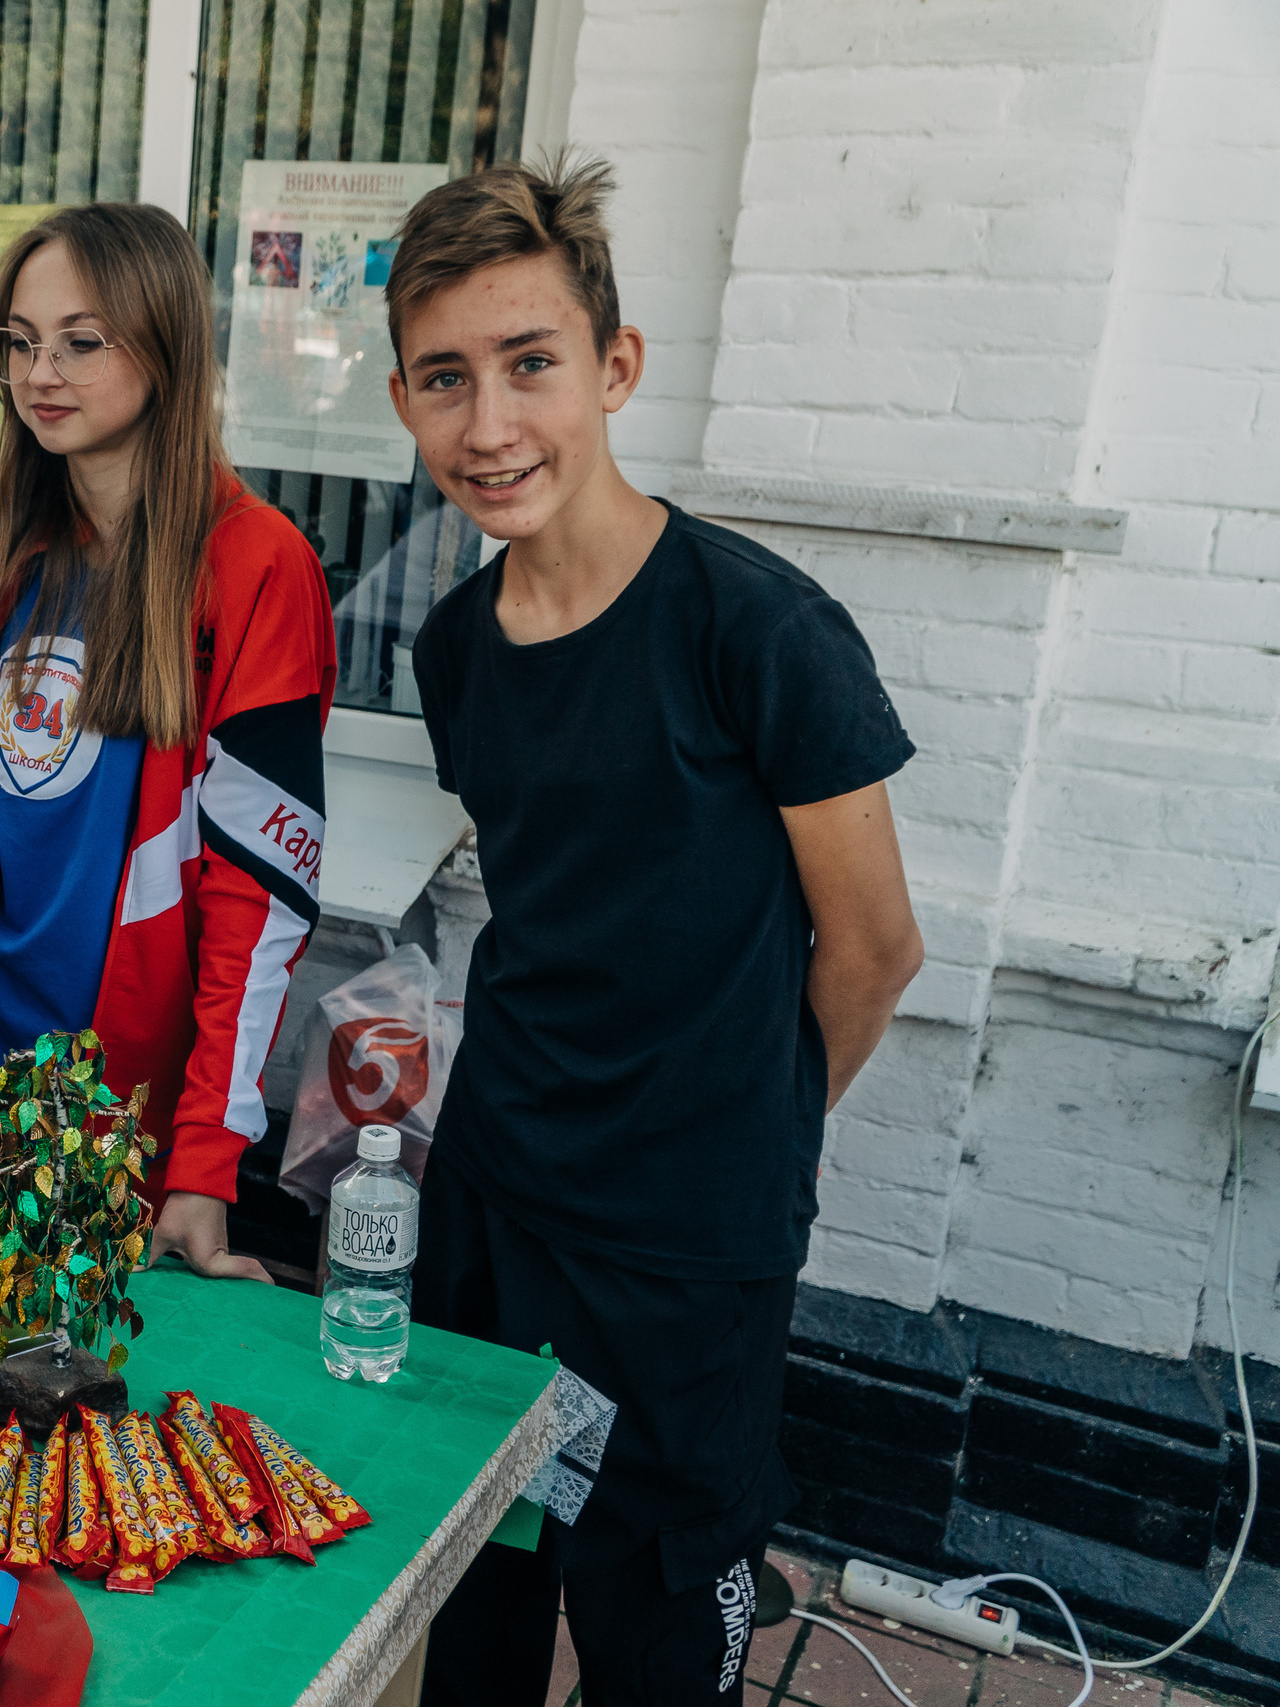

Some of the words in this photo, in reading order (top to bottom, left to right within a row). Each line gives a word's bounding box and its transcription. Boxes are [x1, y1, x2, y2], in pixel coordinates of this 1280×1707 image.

[284, 172, 405, 195] ВНИМАНИЕ!!!
[12, 691, 64, 740] 34
[8, 752, 53, 774] ШКОЛА
[343, 1207, 399, 1235] ТОЛЬКО
[341, 1227, 386, 1257] ВОДА
[740, 1558, 750, 1572] THE
[733, 1562, 746, 1590] ESTON
[741, 1591, 750, 1608] AND
[716, 1568, 745, 1693] OMDERS
